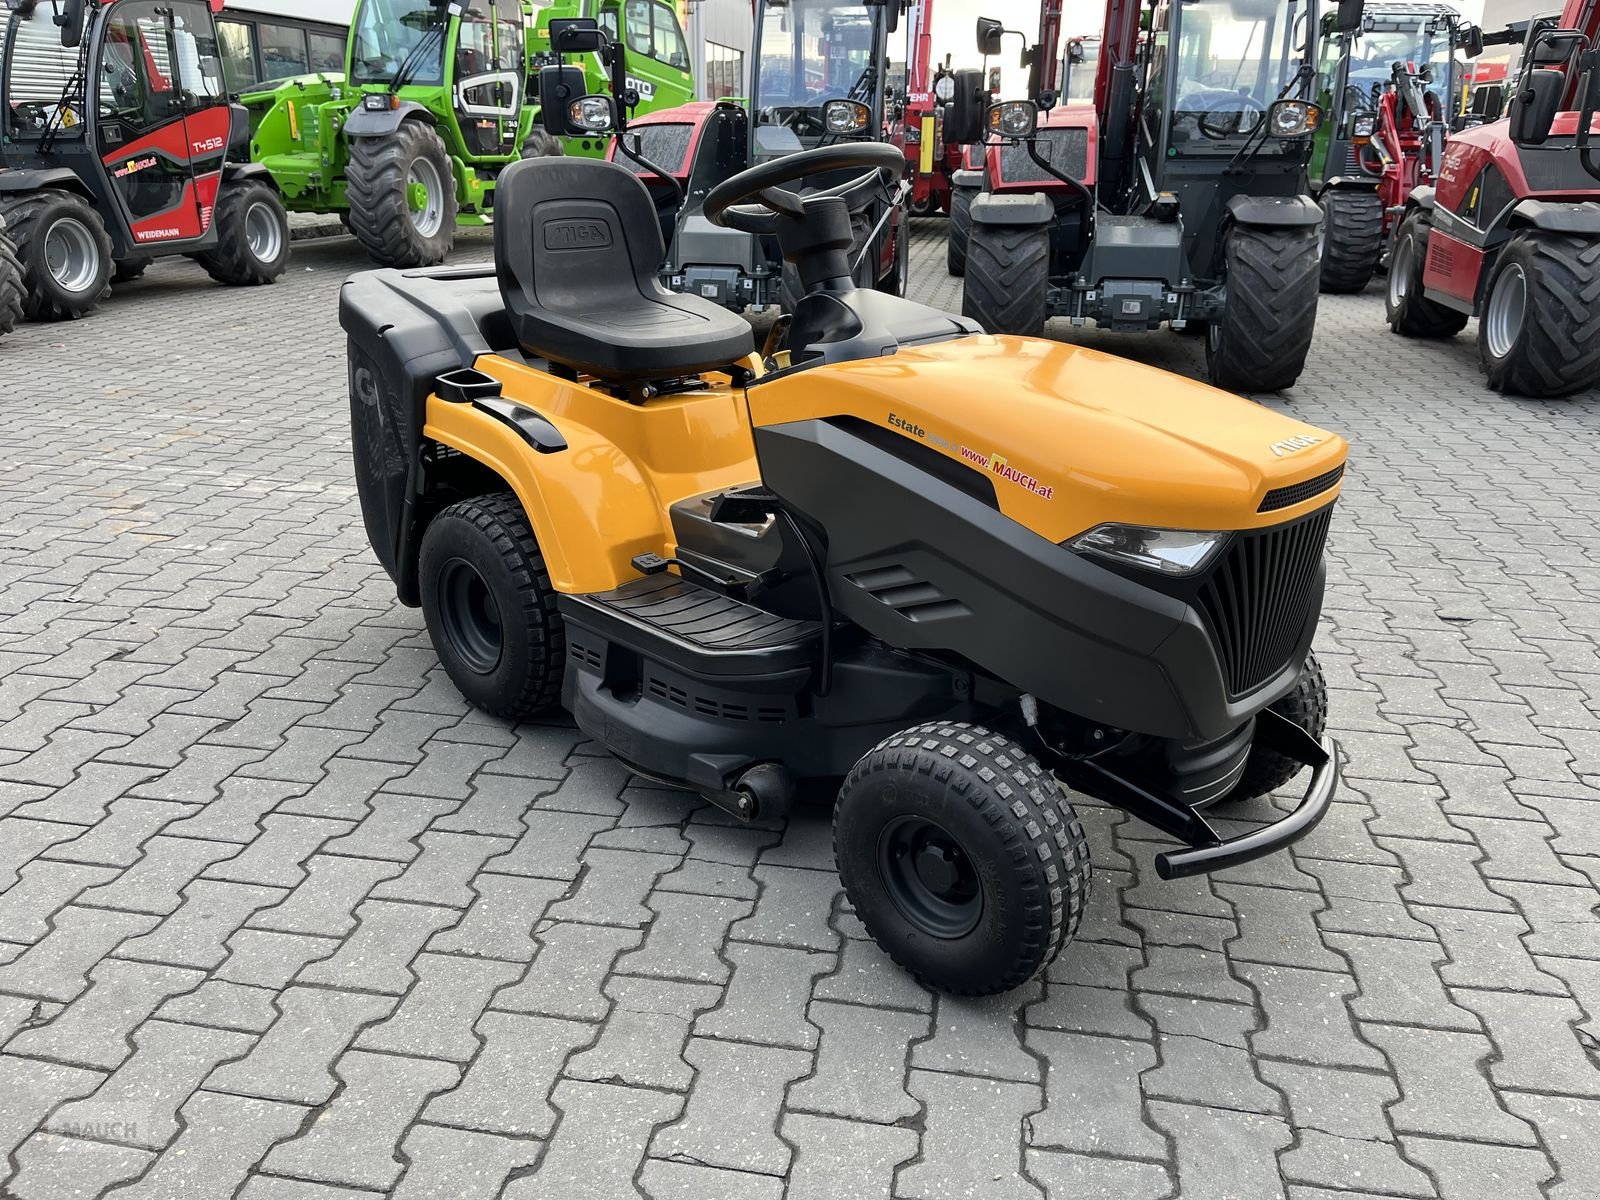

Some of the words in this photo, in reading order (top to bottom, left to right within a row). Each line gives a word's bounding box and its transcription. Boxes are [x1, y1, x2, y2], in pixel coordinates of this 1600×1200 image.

[192, 136, 224, 153] T4512
[136, 228, 180, 240] WEIDEMANN
[548, 224, 606, 246] STIGA
[887, 412, 926, 438] Estate
